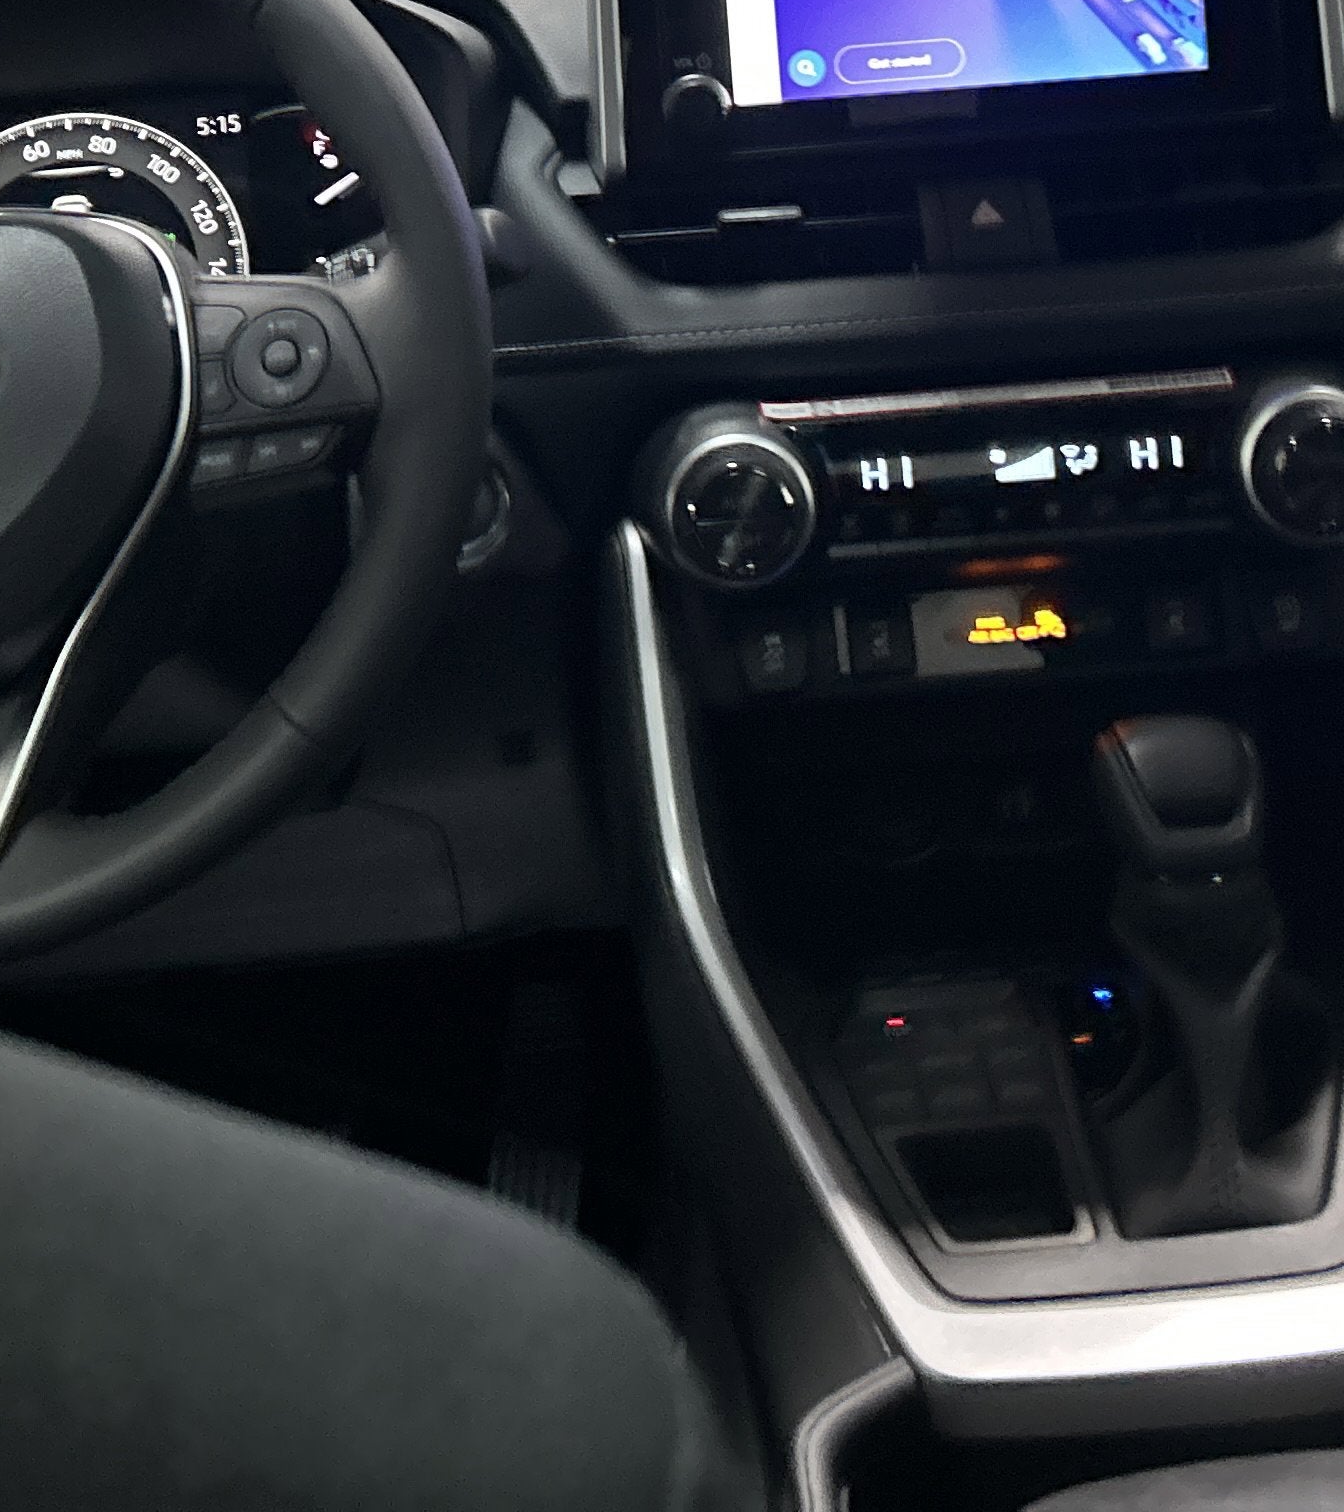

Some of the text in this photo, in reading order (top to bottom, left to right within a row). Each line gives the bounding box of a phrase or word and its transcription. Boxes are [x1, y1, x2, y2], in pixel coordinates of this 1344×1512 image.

[196, 114, 242, 136] 5:15
[22, 140, 50, 162] 60
[56, 149, 84, 161] MPH
[88, 136, 117, 155] 80
[147, 153, 181, 184] 100
[190, 199, 219, 235] 120
[208, 257, 227, 277] 14
